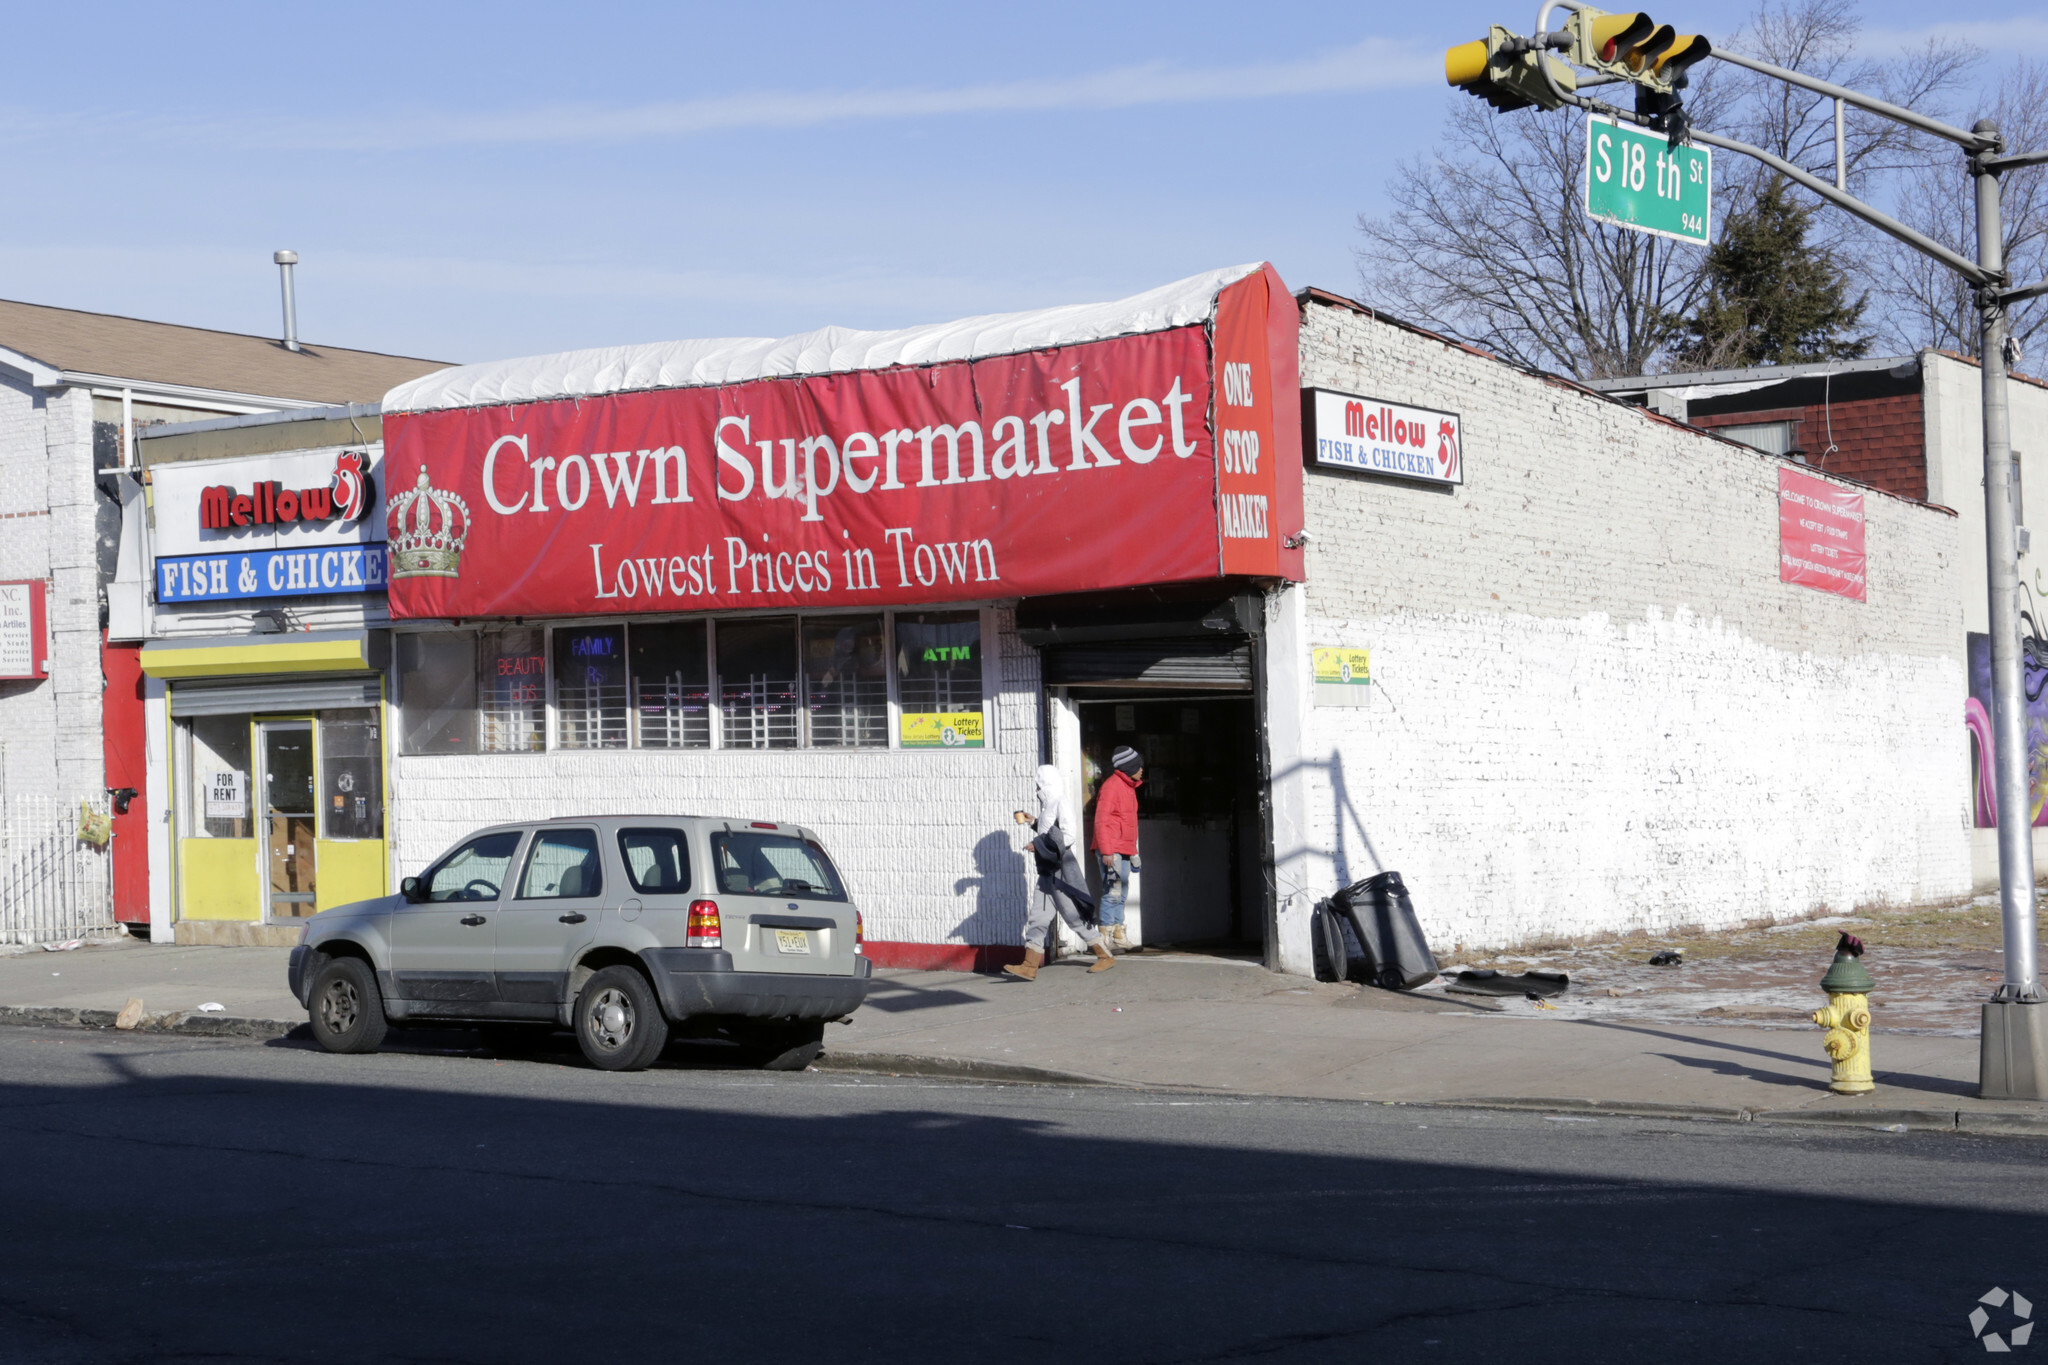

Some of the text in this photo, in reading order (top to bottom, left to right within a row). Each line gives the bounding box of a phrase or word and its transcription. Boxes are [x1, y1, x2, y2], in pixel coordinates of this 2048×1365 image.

[1596, 133, 1703, 201] S 18 th St
[1681, 212, 1702, 234] 944
[1223, 361, 1253, 407] ONE
[1345, 400, 1426, 449] Mellow
[482, 375, 1198, 522] Crown Supermarket
[1223, 428, 1260, 475] STOP
[1318, 438, 1435, 476] FISH & CHICKEN
[200, 480, 333, 530] Mellow
[1805, 496, 1814, 508] TO
[1221, 493, 1269, 539] MARKET
[589, 526, 1001, 599] Lowest Prices in Town
[161, 549, 388, 598] FISH & CHICKE
[0, 588, 21, 602] NC.
[4, 605, 23, 617] Inc.
[571, 636, 613, 656] FAMILY
[923, 645, 971, 662] ATM
[497, 656, 546, 676] BEAUTY
[1348, 653, 1367, 666] Lottery
[953, 717, 980, 728] Lottery
[957, 727, 982, 737] Tickets
[216, 773, 234, 787] FOR
[213, 788, 237, 801] RENT
